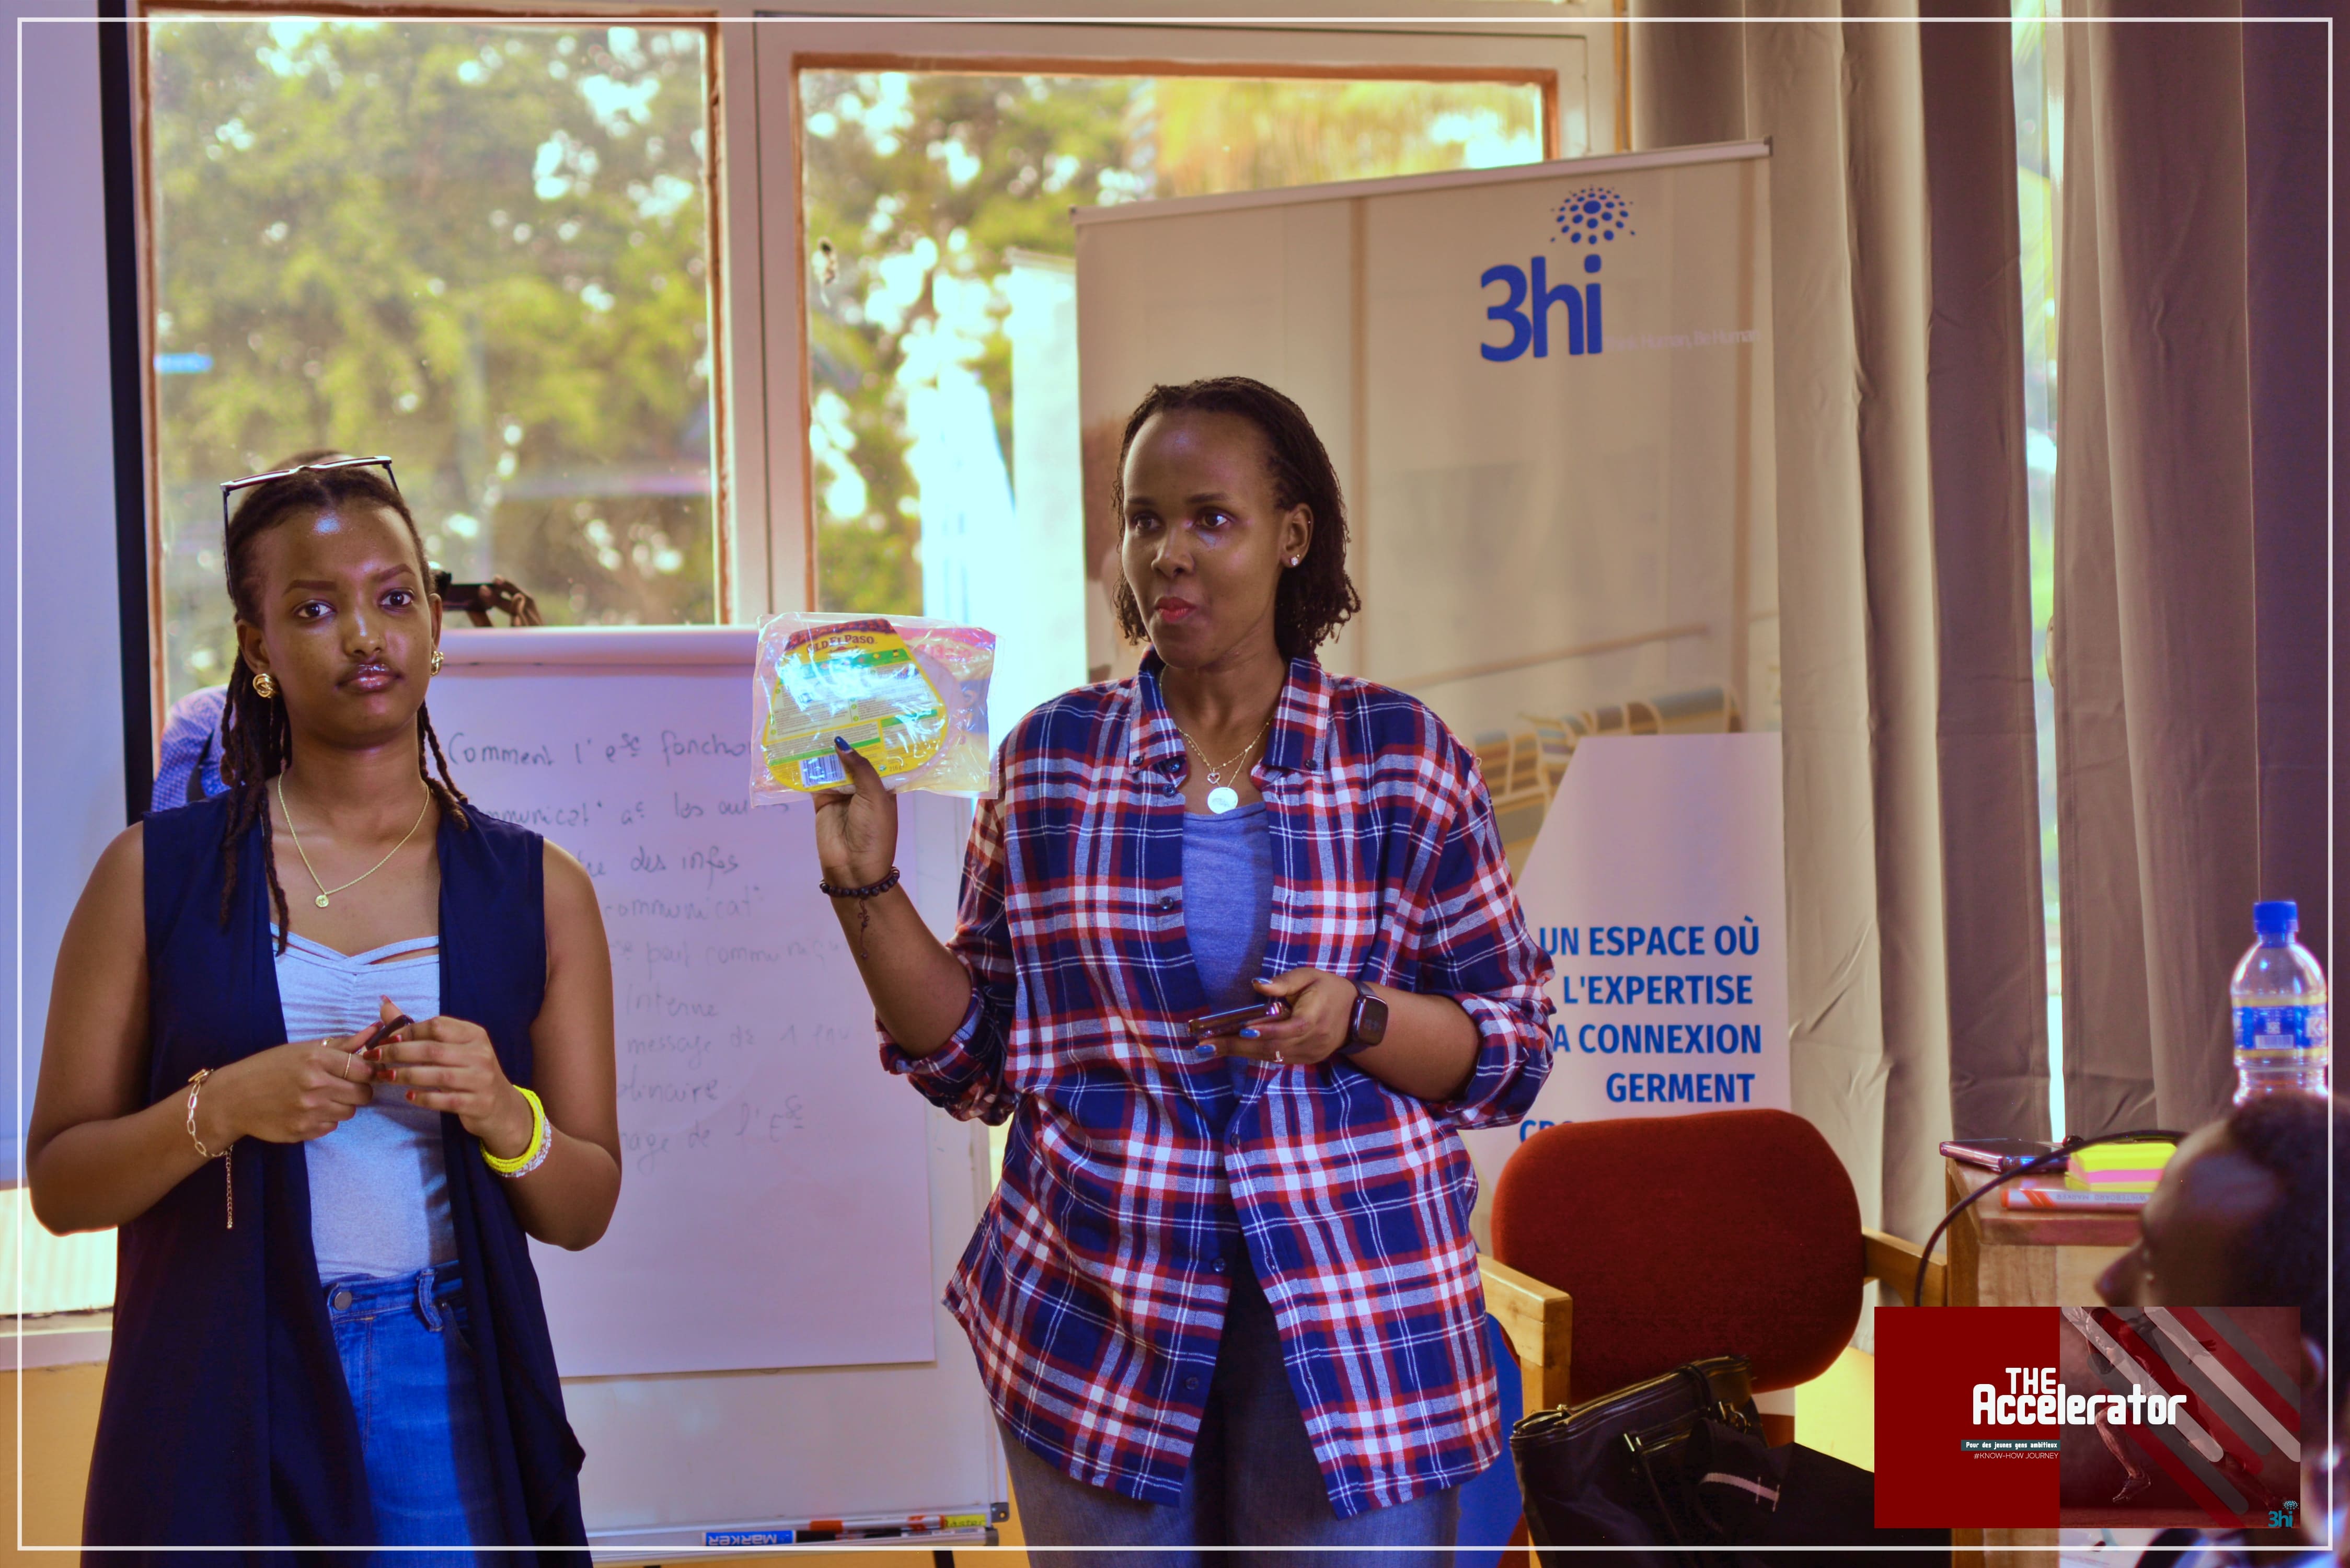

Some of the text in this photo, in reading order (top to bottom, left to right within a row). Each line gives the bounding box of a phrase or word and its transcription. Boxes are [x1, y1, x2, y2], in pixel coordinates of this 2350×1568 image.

[1481, 254, 1603, 362] 3hi
[449, 732, 554, 766] Comment
[1539, 915, 1759, 955] UN ESPACE OÙ
[1563, 975, 1753, 1004] L'EXPERTISE
[1552, 1024, 1761, 1054] A CONNEXION
[1606, 1073, 1755, 1103] GERMENT
